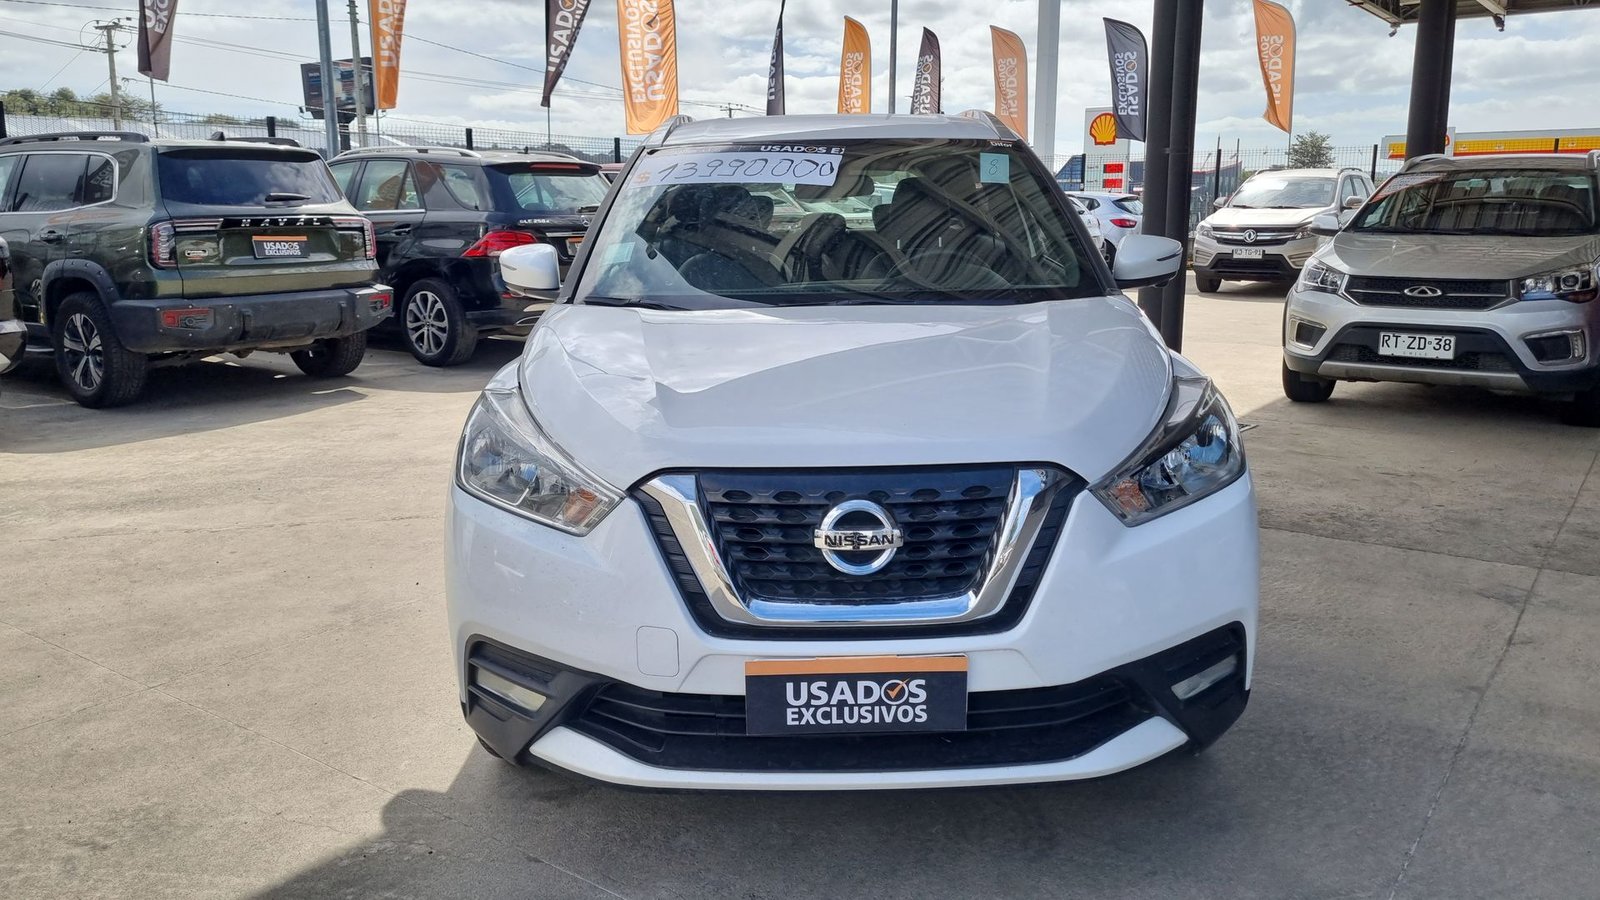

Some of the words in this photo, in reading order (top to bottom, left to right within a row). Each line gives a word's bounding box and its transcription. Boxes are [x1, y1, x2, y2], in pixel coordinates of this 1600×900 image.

[760, 145, 827, 154] USADOS
[988, 159, 999, 176] 8
[241, 218, 321, 227] HAVAL
[263, 242, 300, 250] USADOS
[824, 533, 895, 547] NISSAN
[785, 678, 928, 706] USADOS
[785, 704, 928, 726] EXCLUSIVOS
